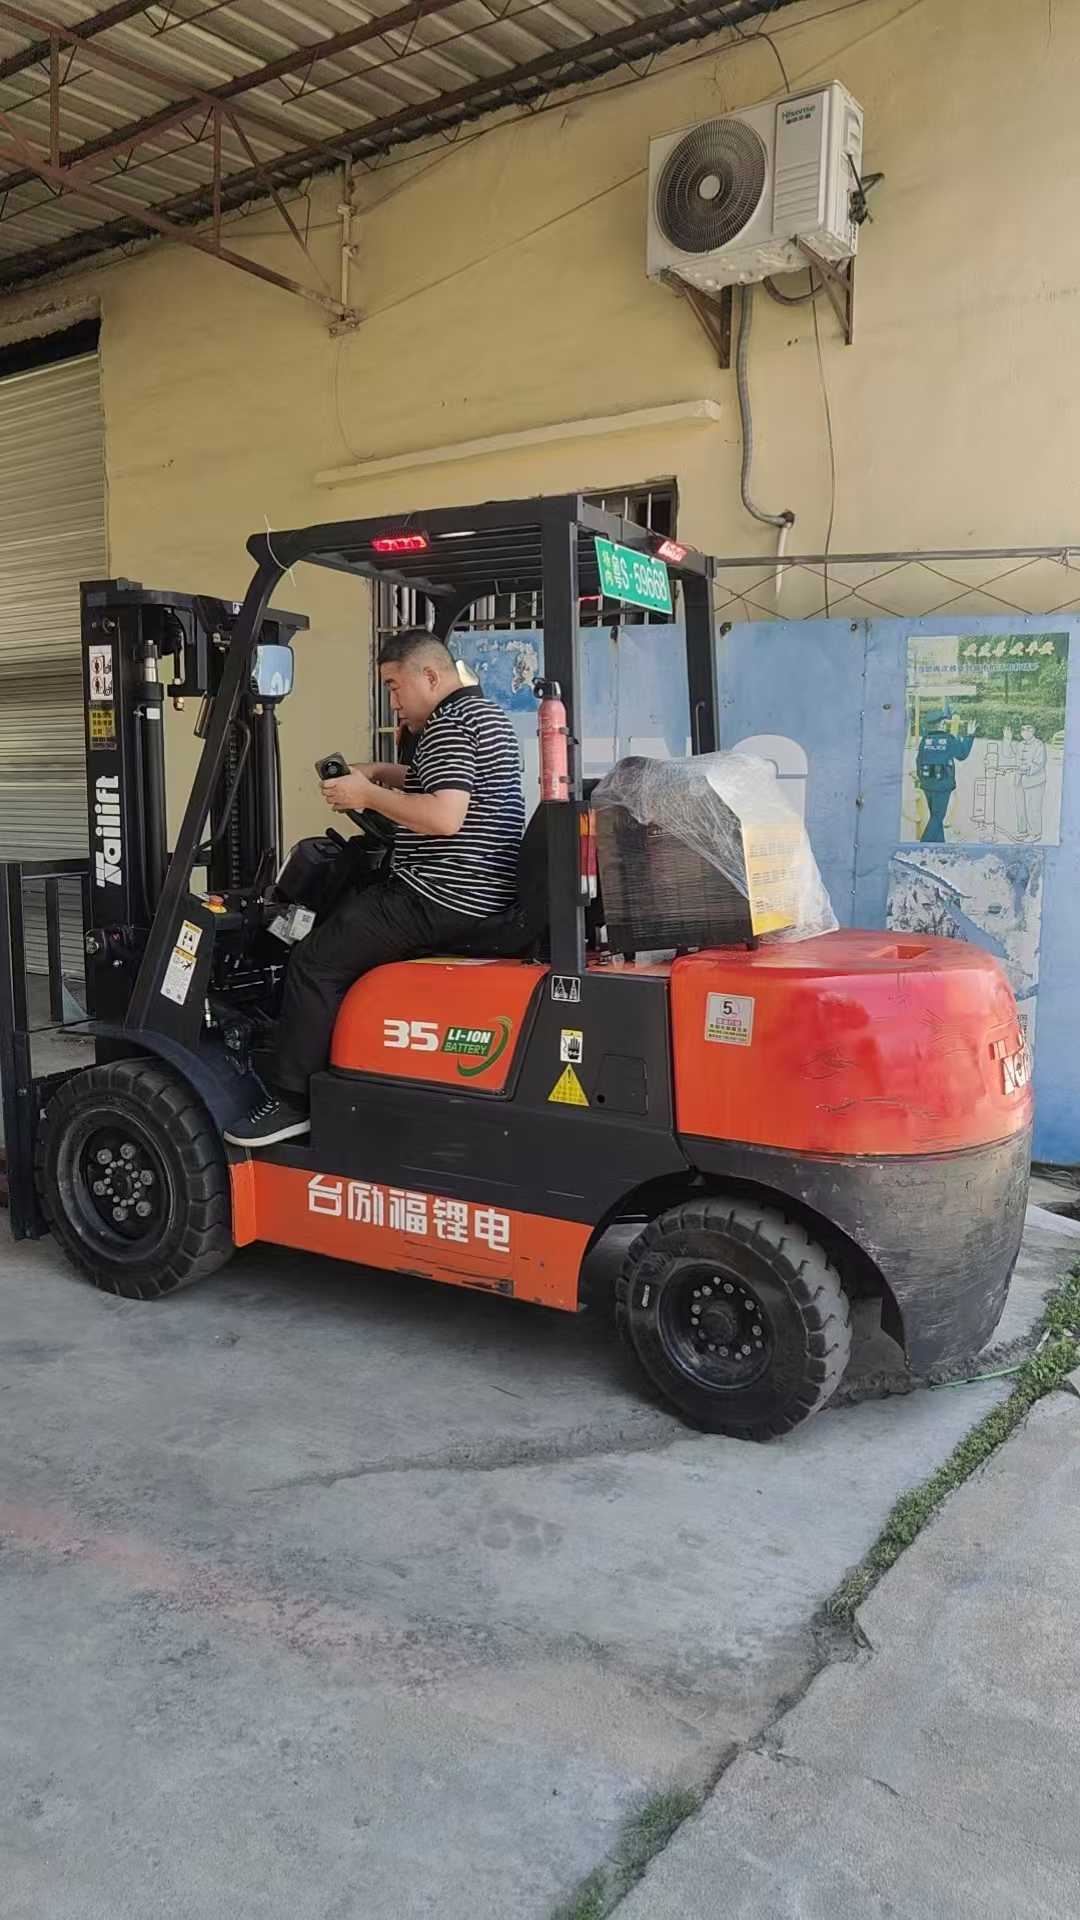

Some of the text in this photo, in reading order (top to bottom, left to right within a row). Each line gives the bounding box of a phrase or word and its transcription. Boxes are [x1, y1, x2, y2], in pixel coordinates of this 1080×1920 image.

[95, 775, 122, 888] Tailift
[384, 1018, 492, 1052] 35 LI-ION
[444, 1042, 488, 1055] BATTERY
[308, 1174, 510, 1253] 台励福锂电
